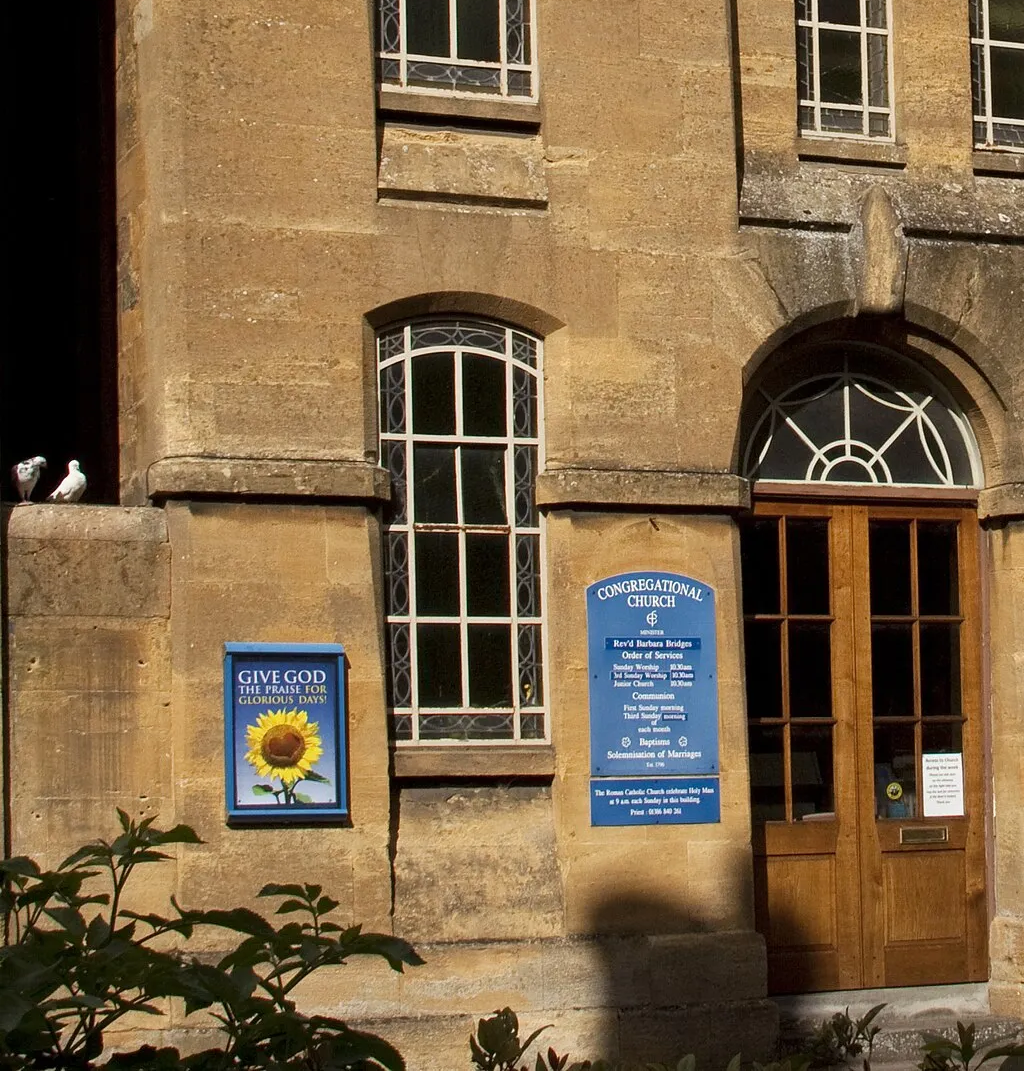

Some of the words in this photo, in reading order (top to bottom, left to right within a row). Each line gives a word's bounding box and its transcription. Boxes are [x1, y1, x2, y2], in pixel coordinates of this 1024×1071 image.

[597, 578, 703, 602] CONGREGATIONAL
[627, 594, 676, 608] CHURCH
[613, 640, 634, 648] Rev'd
[666, 640, 692, 649] Bridges
[622, 651, 643, 659] Order
[644, 651, 652, 659] of
[655, 651, 683, 659] Services
[613, 664, 634, 672] Sunday
[635, 664, 659, 672] Worship
[238, 670, 280, 684] GIVE
[284, 669, 326, 684] GOD
[623, 672, 643, 680] Sunday
[645, 672, 667, 680] Worship
[238, 685, 261, 694] THE
[265, 685, 301, 694] PRAISE
[305, 685, 327, 694] FOR
[238, 695, 294, 704] GLORIOUS
[298, 695, 327, 704] DAYS!
[632, 692, 675, 700] Communion
[639, 737, 670, 747] Baptisms
[607, 750, 655, 759] Solemnisation
[657, 750, 665, 758] of
[668, 750, 702, 759] Marriages
[625, 788, 645, 796] Catholic
[644, 797, 661, 805] Sunday
